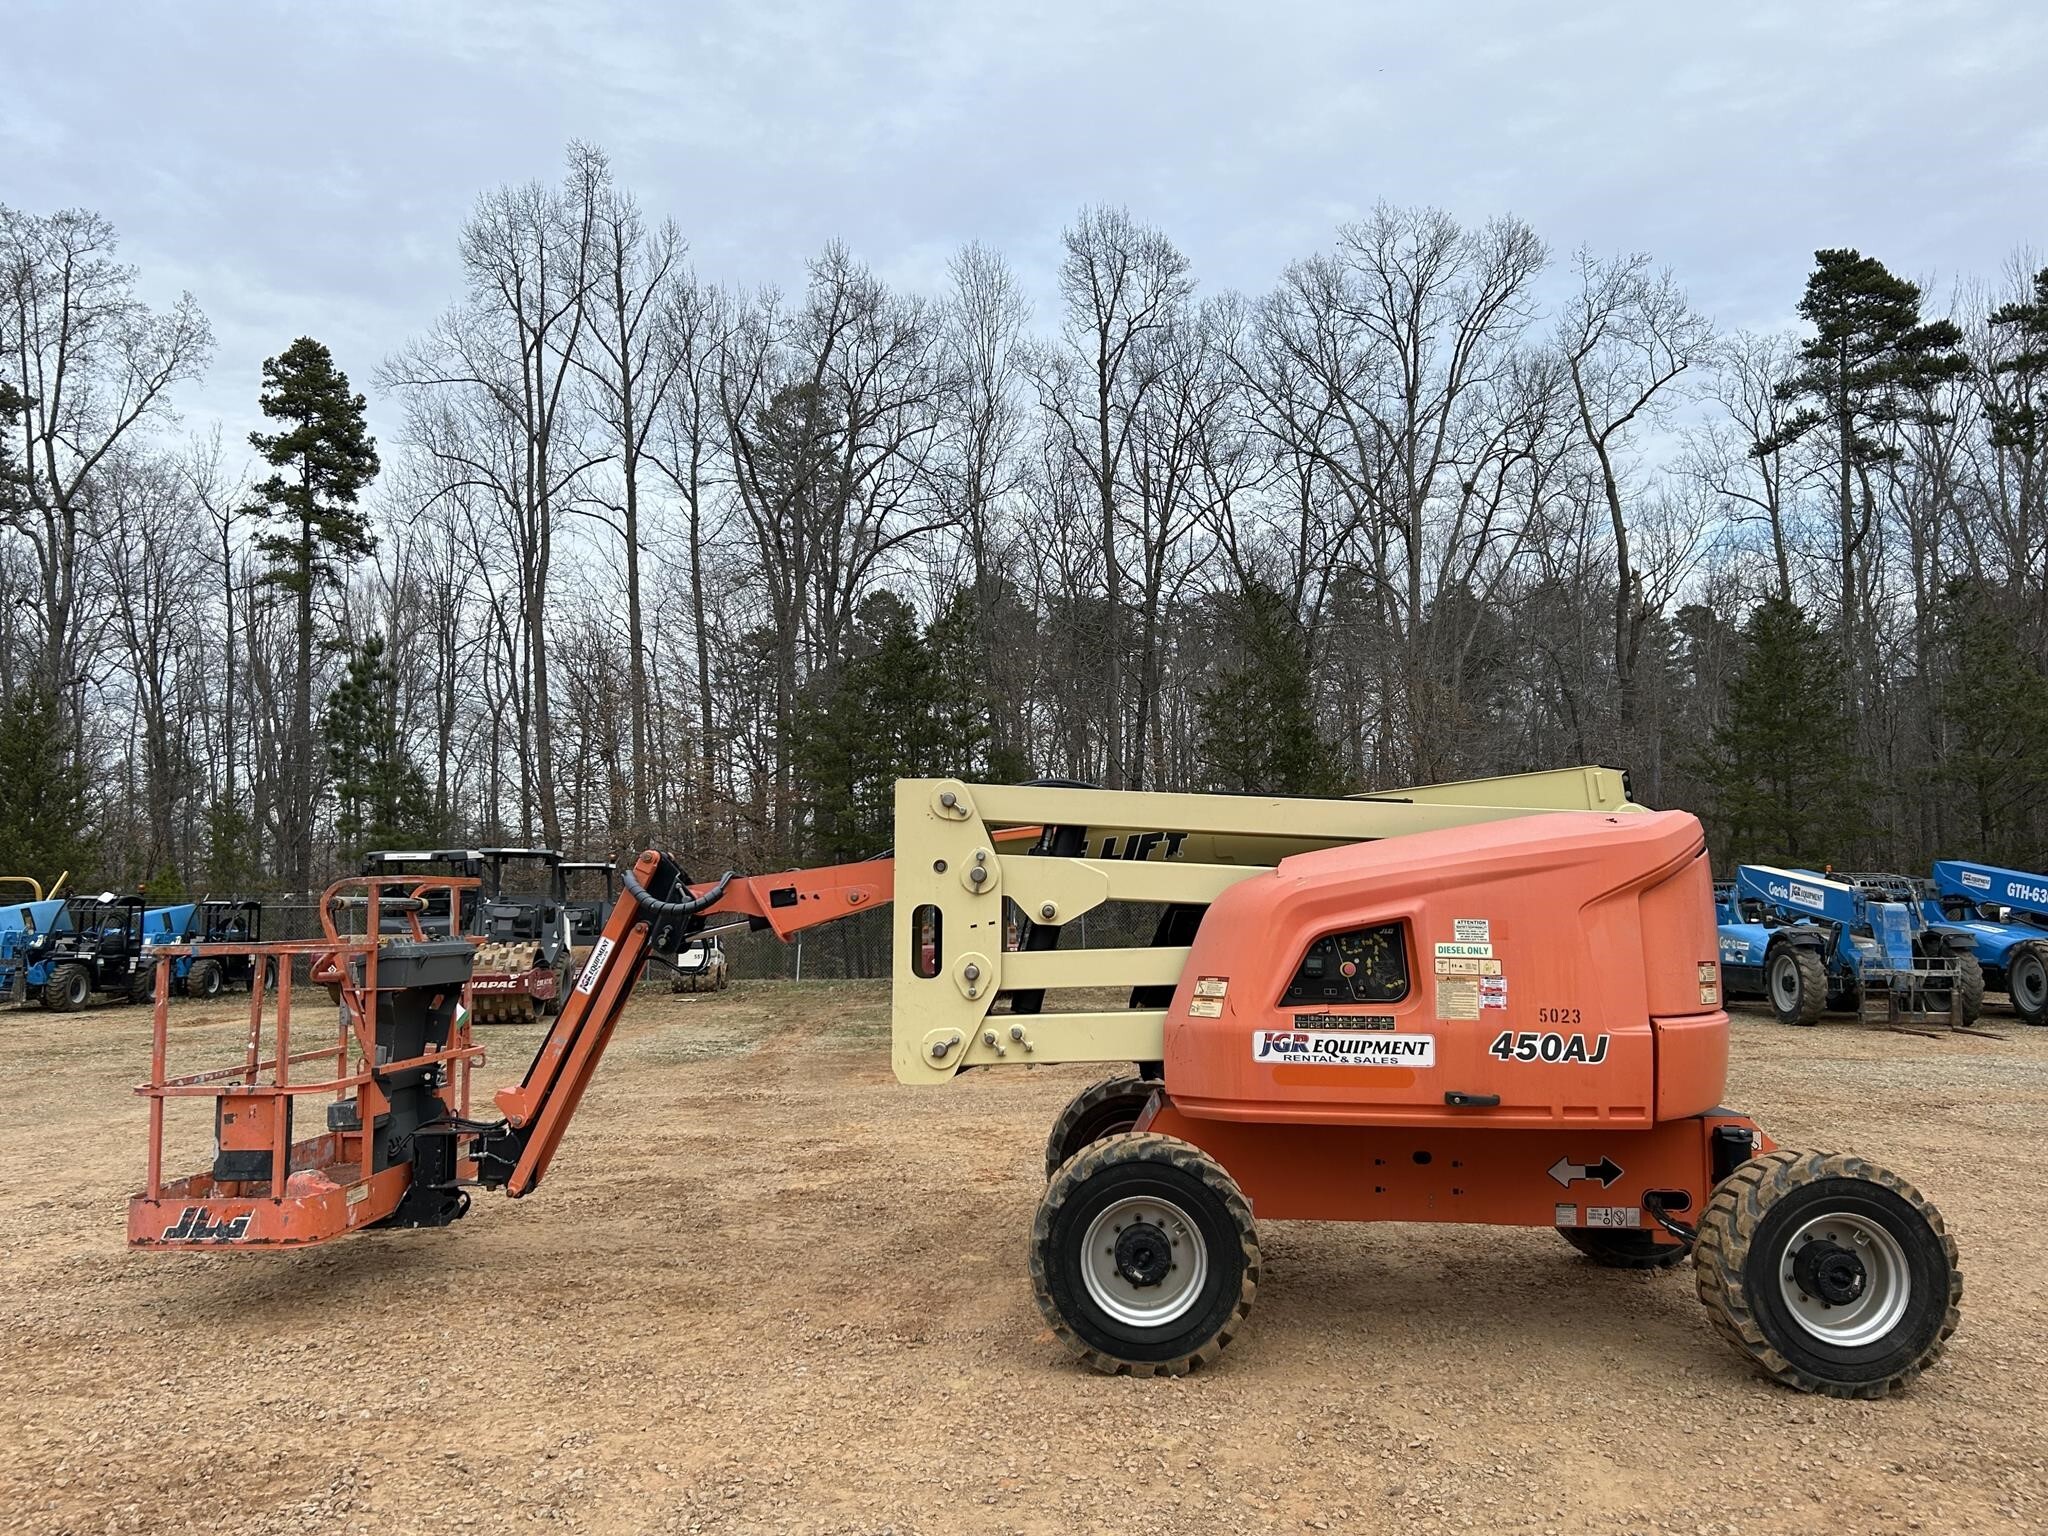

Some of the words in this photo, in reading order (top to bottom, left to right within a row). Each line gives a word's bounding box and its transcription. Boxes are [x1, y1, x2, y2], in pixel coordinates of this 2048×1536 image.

[1100, 832, 1189, 860] LIFT
[1768, 881, 1788, 899] Genie
[2007, 882, 2048, 904] GTH-63
[1438, 945, 1465, 954] DIESEL
[1467, 946, 1489, 955] ONLY
[1539, 1008, 1581, 1024] 5023
[1258, 1032, 1310, 1057] JGR
[1312, 1039, 1430, 1058] EQUIPMENT
[1489, 1031, 1610, 1064] 450AJ
[1283, 1054, 1335, 1063] RENTAL
[1340, 1055, 1349, 1063] &
[1353, 1056, 1399, 1065] SALES
[161, 1205, 256, 1240] JLG
